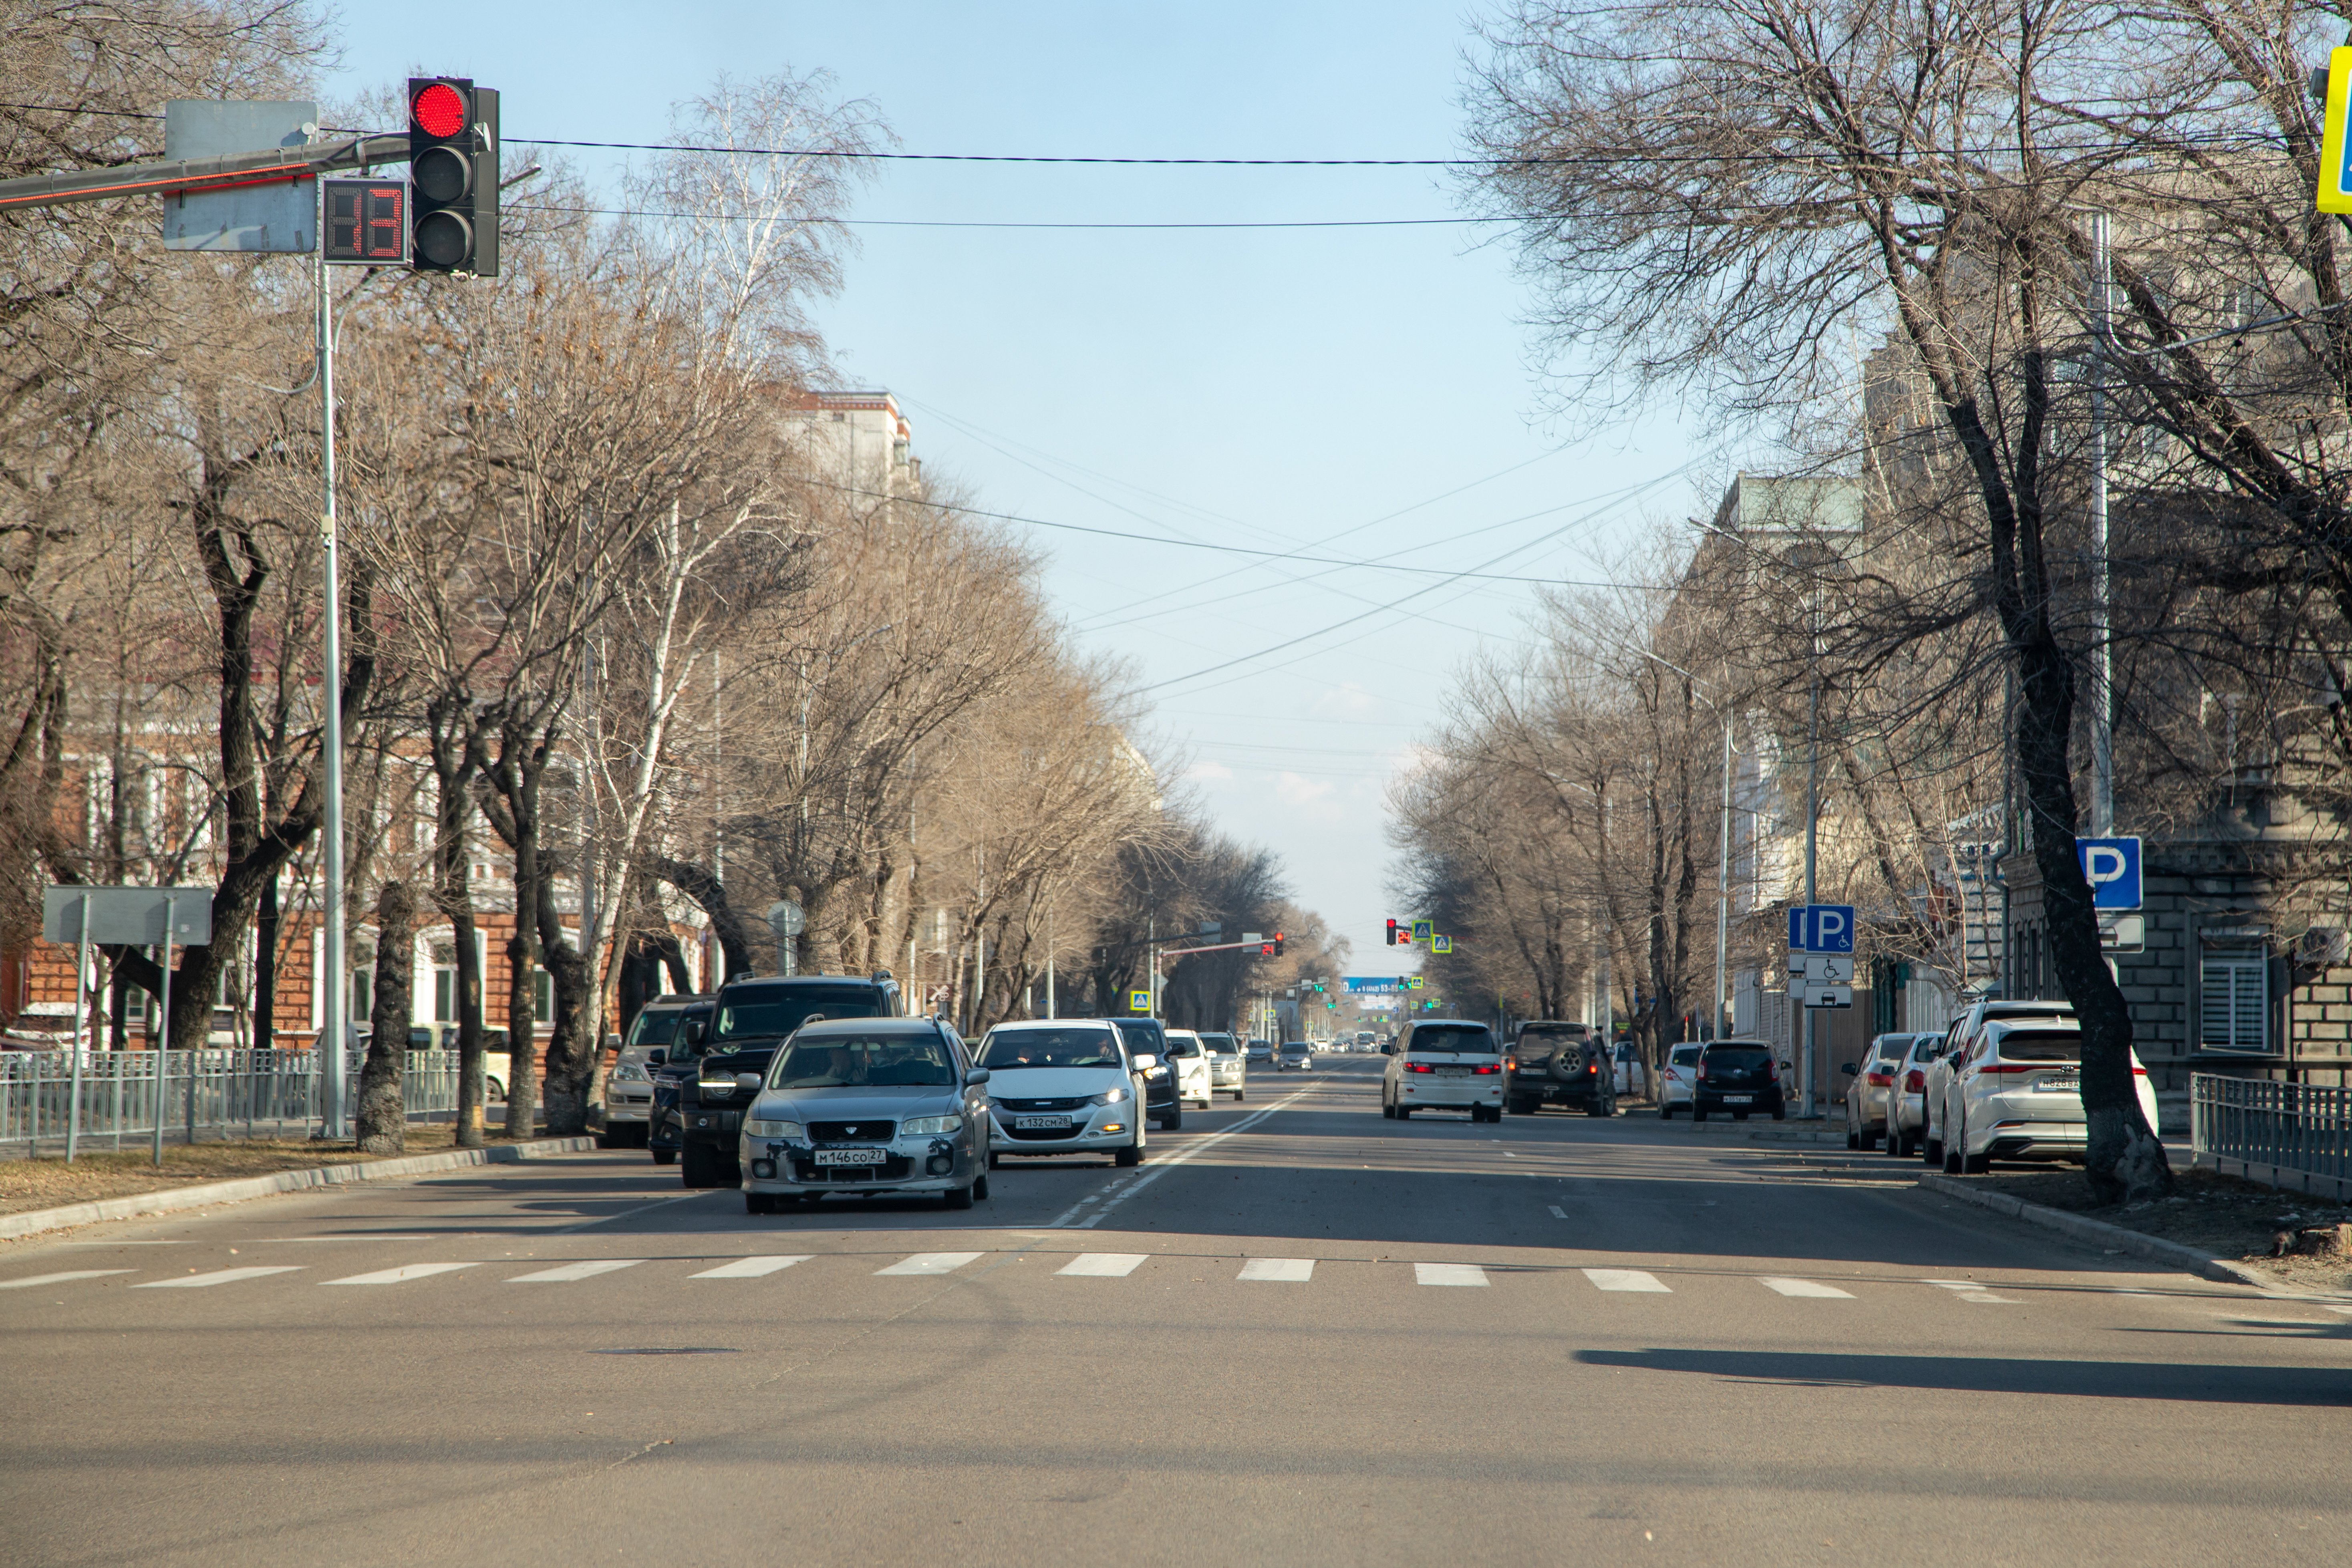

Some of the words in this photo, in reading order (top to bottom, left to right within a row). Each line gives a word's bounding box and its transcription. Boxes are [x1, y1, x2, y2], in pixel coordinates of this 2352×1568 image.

[353, 189, 402, 256] 13
[2086, 847, 2126, 902] P
[1398, 932, 1410, 944] 24
[1818, 911, 1845, 947] P
[1263, 945, 1273, 955] 24
[870, 1150, 882, 1159] 27
